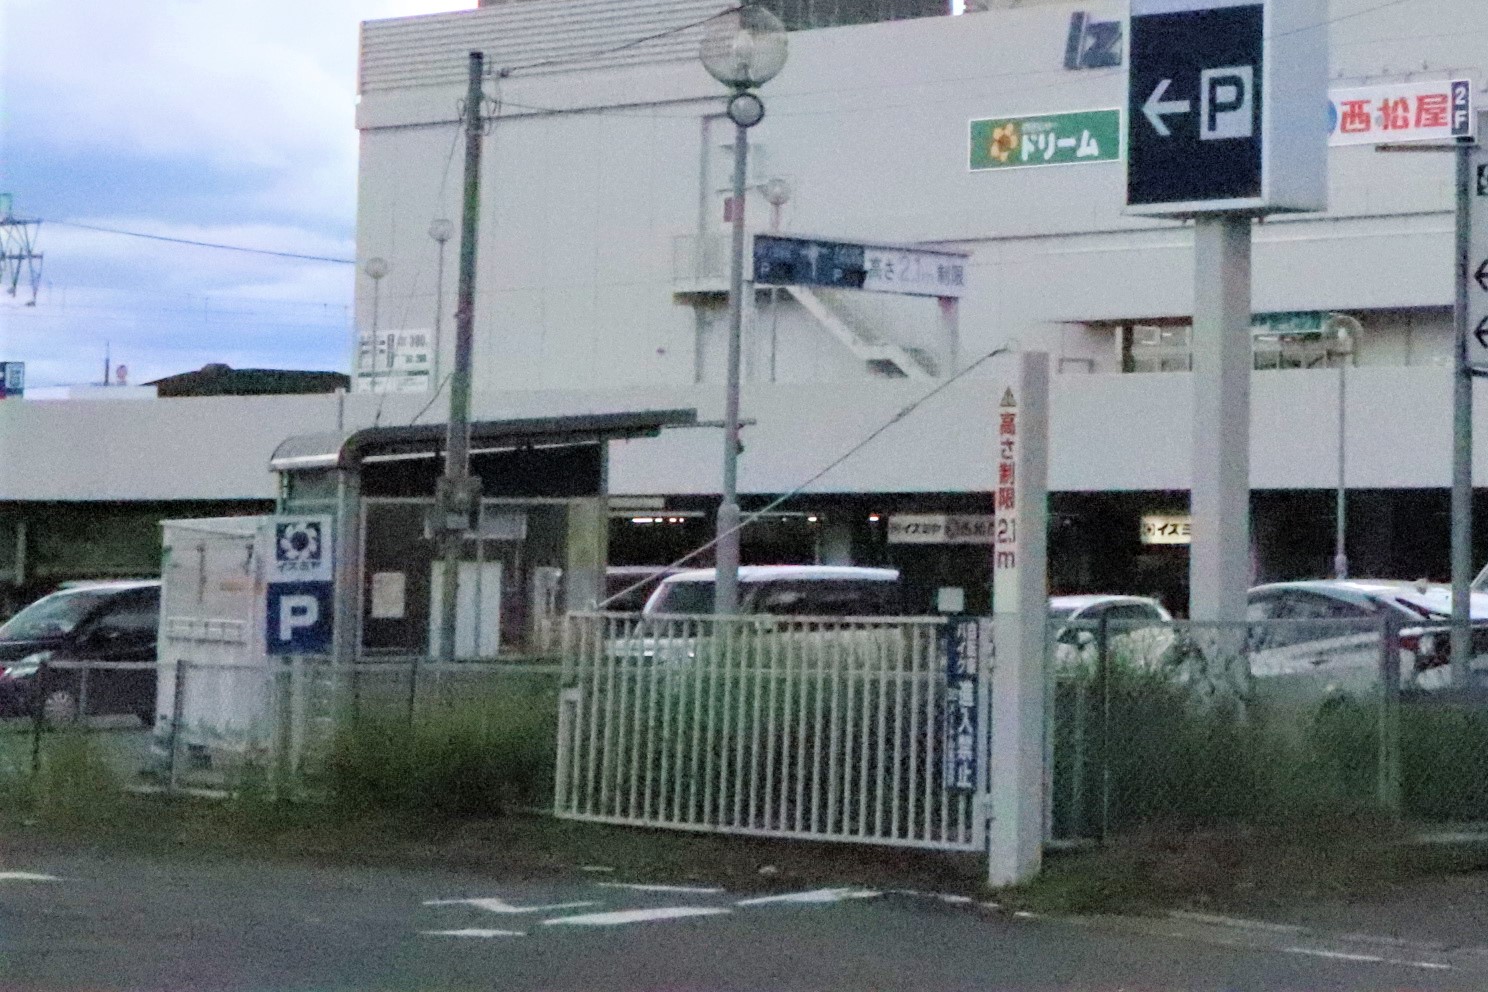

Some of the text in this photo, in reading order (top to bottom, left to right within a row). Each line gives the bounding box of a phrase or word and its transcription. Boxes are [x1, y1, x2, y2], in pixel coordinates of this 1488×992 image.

[1207, 75, 1245, 132] P
[1340, 94, 1448, 133] 西松屋
[1454, 87, 1467, 130] 2F
[1021, 129, 1099, 161] ドリーム
[1157, 522, 1192, 537] イズミ
[279, 594, 320, 641] P
